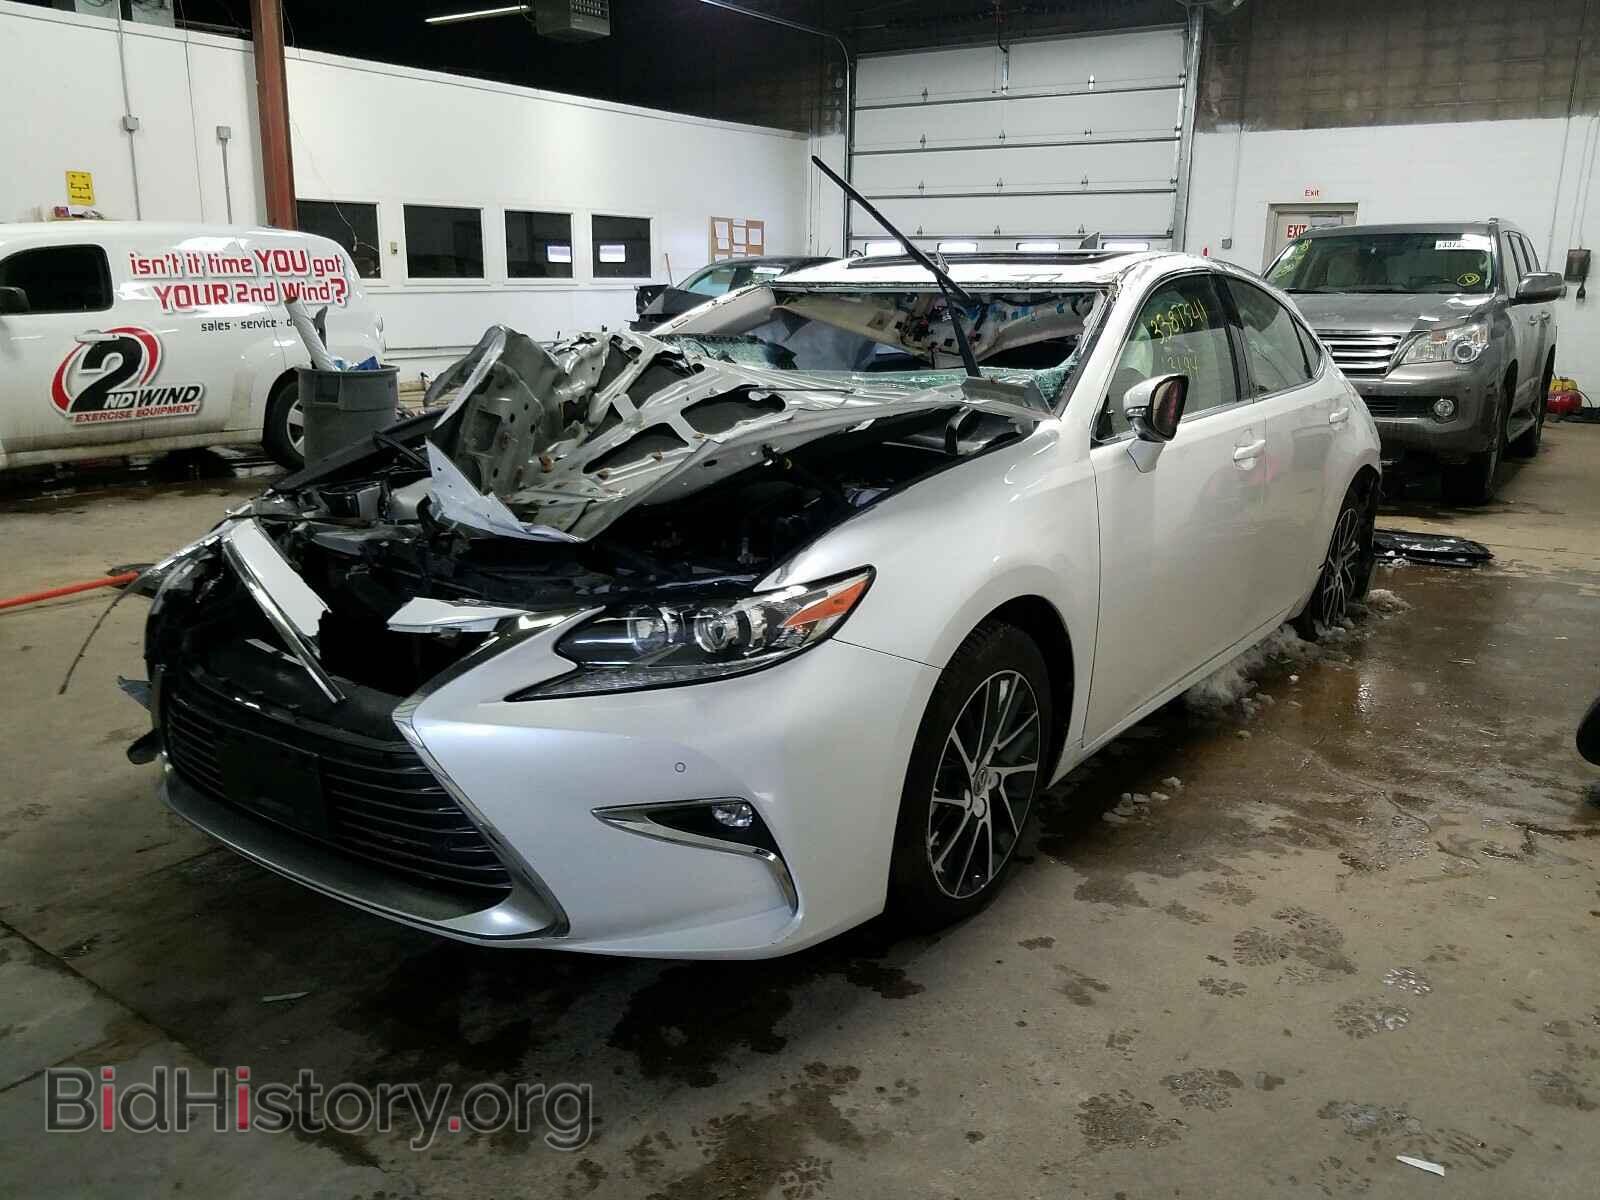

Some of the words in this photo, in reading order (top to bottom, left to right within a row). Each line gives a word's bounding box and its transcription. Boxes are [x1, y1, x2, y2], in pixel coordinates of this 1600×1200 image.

[1304, 189, 1320, 197] Exit
[1287, 224, 1308, 239] EXIT
[130, 252, 181, 275] isn't
[187, 253, 201, 274] it
[207, 253, 253, 274] time
[254, 248, 308, 274] YOU
[313, 254, 343, 277] got
[153, 283, 231, 310] YOUR
[235, 282, 277, 303] 2nd
[281, 277, 347, 304] Wind?
[200, 319, 231, 332] sales
[240, 317, 277, 330] service
[137, 385, 201, 407] WIND
[75, 409, 133, 423] EXERCISE
[135, 403, 198, 418] EQUIPMENT
